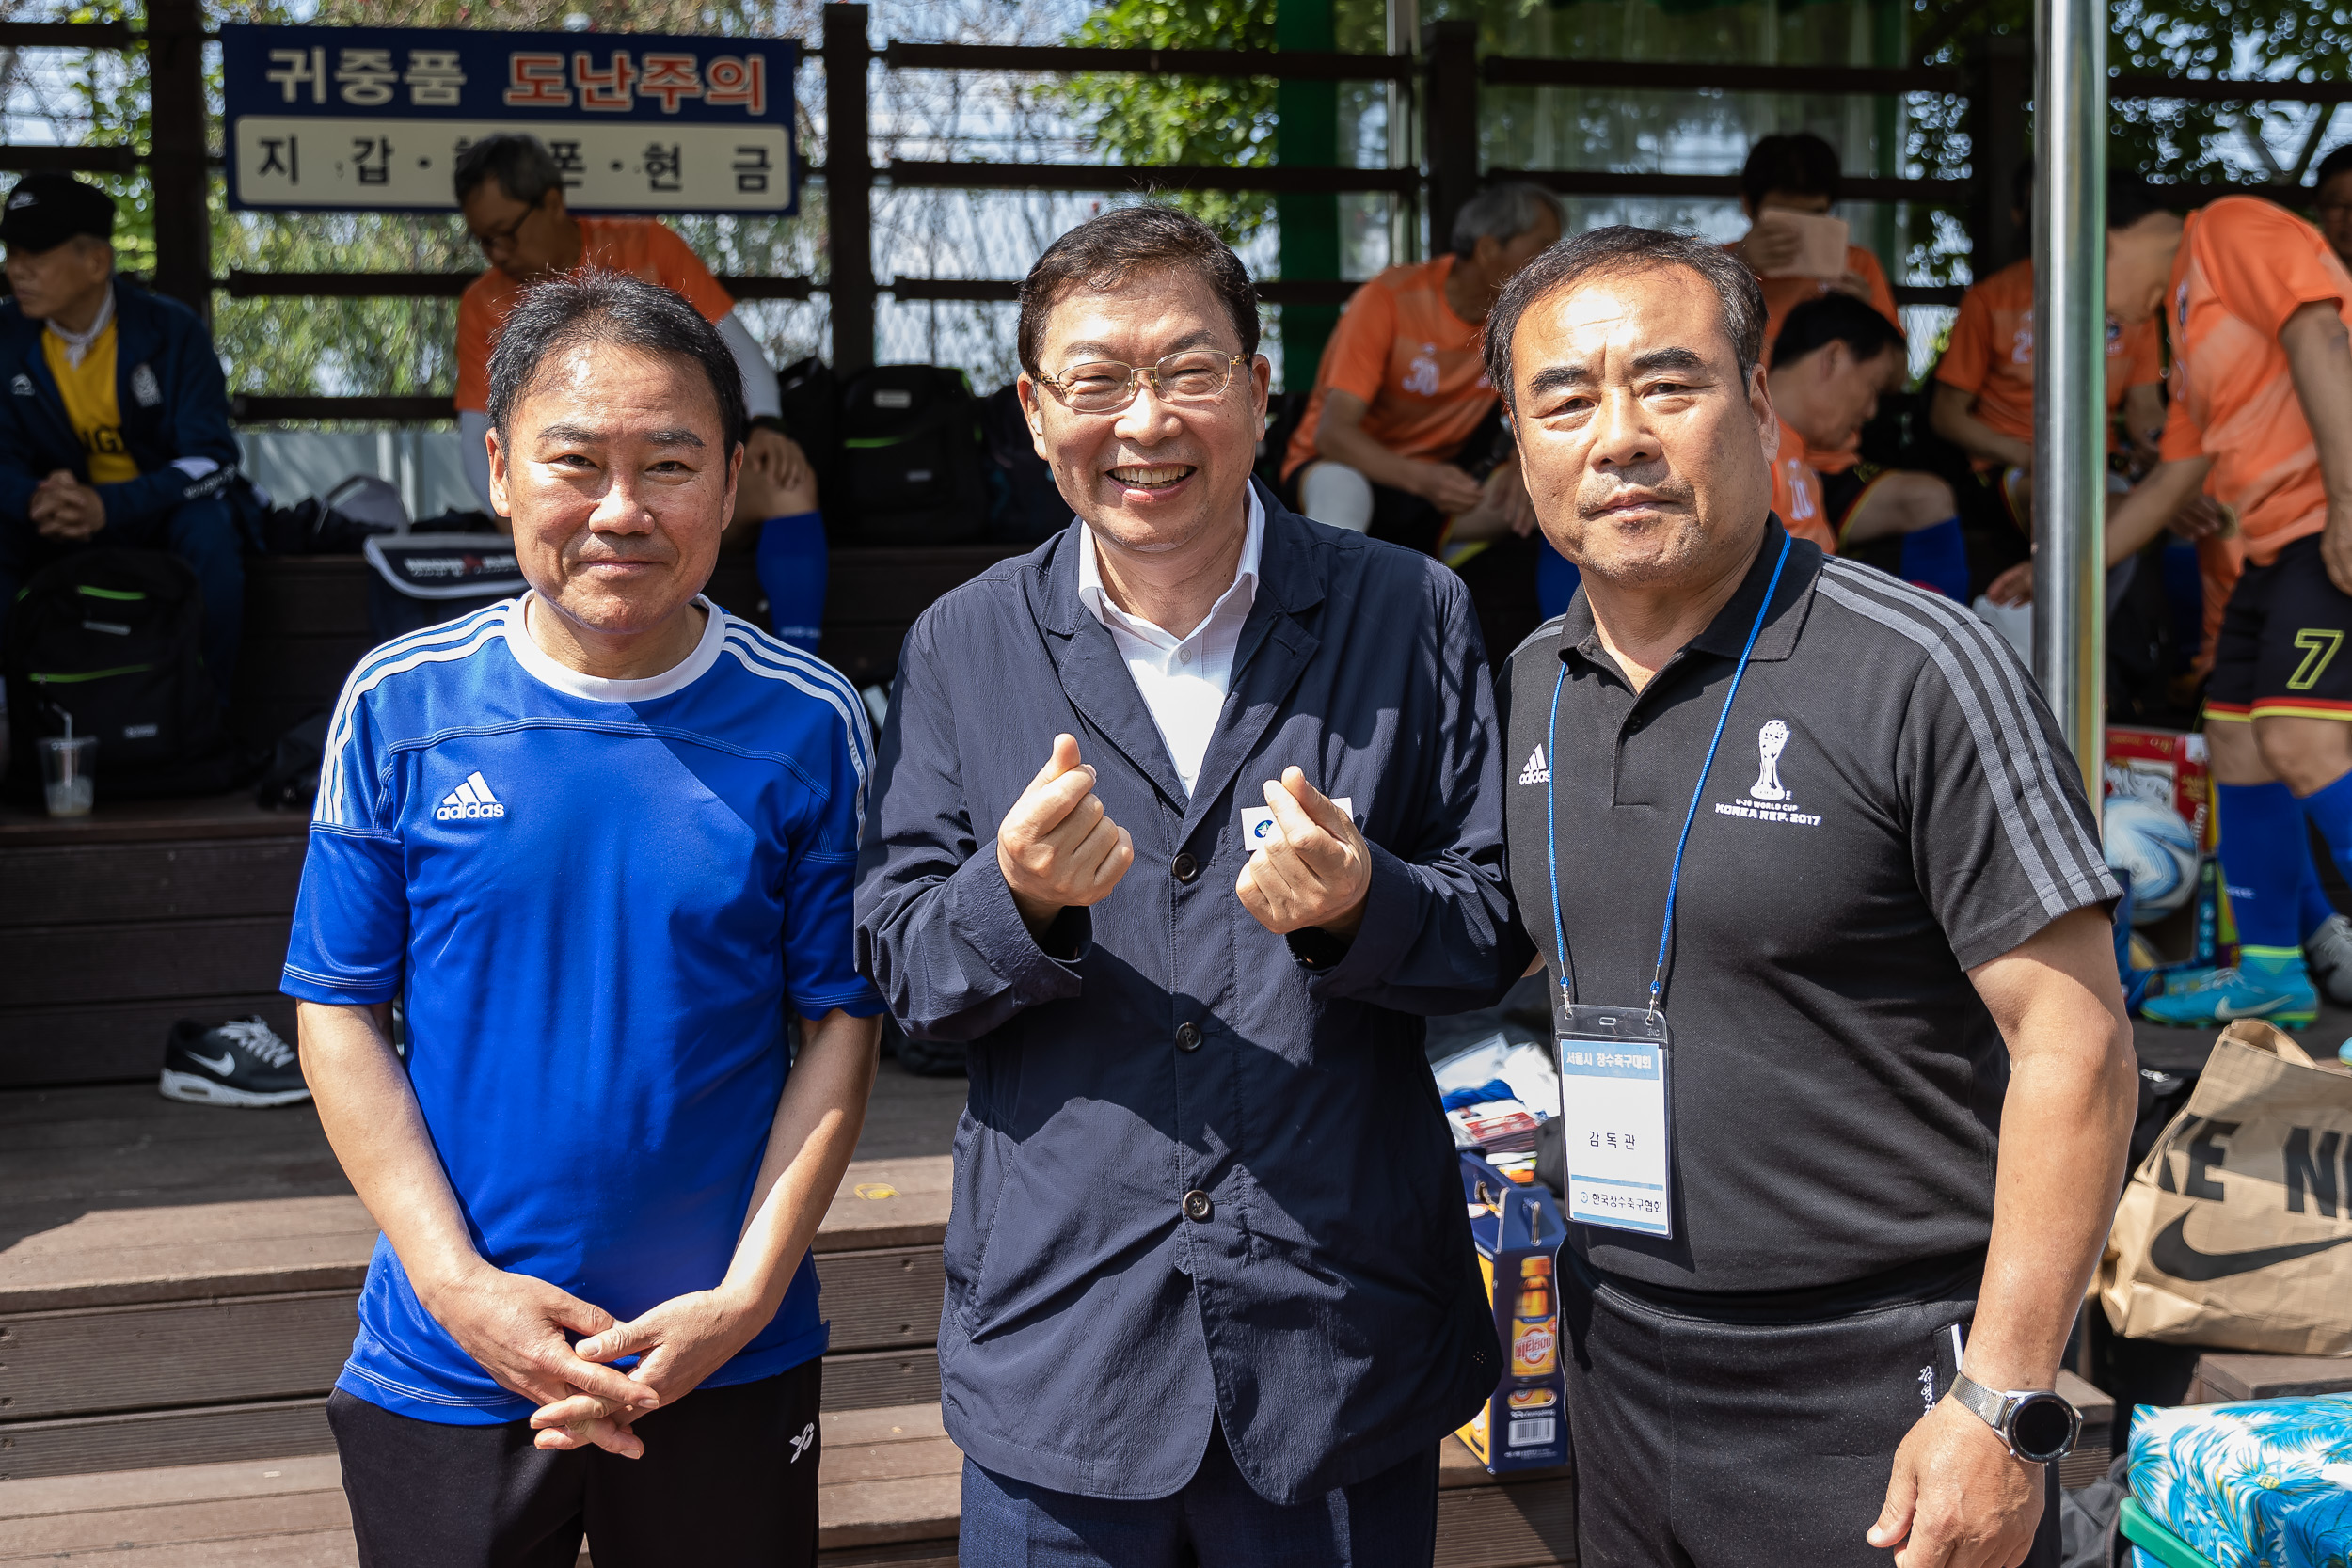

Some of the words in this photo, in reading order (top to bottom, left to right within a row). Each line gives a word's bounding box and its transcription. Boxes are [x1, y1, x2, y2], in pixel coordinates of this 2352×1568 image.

[265, 46, 467, 106] 귀중품
[502, 50, 767, 116] 도난주의
[2286, 627, 2345, 690] 7
[1518, 768, 1550, 786] adidas
[436, 801, 505, 821] adidas
[1715, 803, 1758, 818] KOREA
[1759, 810, 1788, 822] REP.
[1789, 813, 1821, 826] 2017
[1735, 798, 1753, 807] U-20
[1753, 800, 1782, 811] WORLD
[1565, 1051, 1593, 1067] 서울시
[1597, 1053, 1652, 1069] 장수축구대회
[1592, 1193, 1663, 1214] 한국장수축구협회
